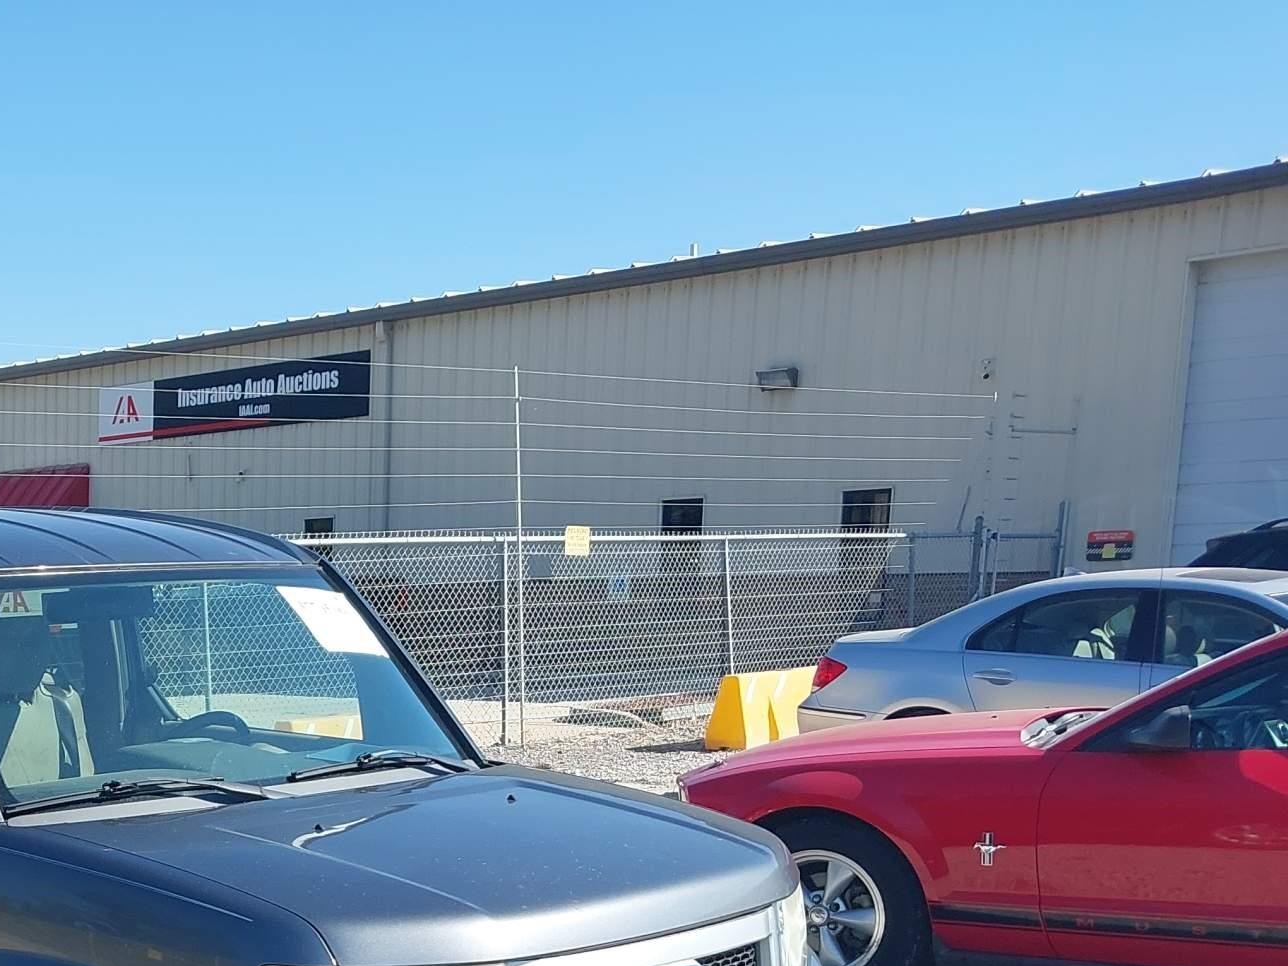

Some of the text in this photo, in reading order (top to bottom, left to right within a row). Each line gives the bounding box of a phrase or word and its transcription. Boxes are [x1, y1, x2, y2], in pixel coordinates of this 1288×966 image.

[177, 370, 339, 408] Insurance Auto Auctions
[238, 403, 270, 417] IAAI.com
